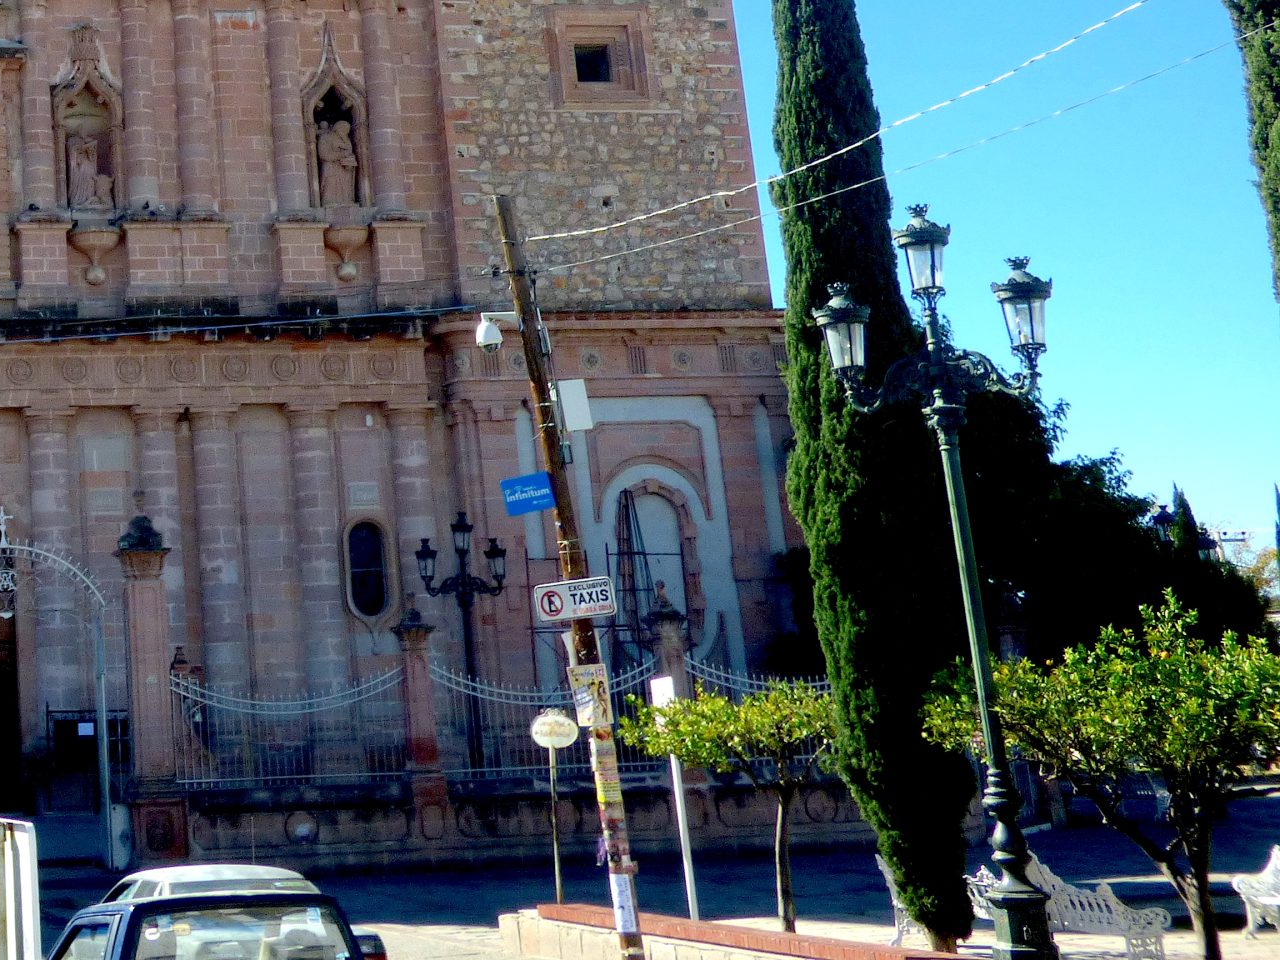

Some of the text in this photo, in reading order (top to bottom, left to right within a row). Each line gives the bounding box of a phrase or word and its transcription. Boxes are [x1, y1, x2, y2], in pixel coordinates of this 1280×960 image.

[505, 488, 550, 502] infinitum
[568, 581, 608, 592] EXCLUSIVO
[570, 589, 609, 606] TAXIS
